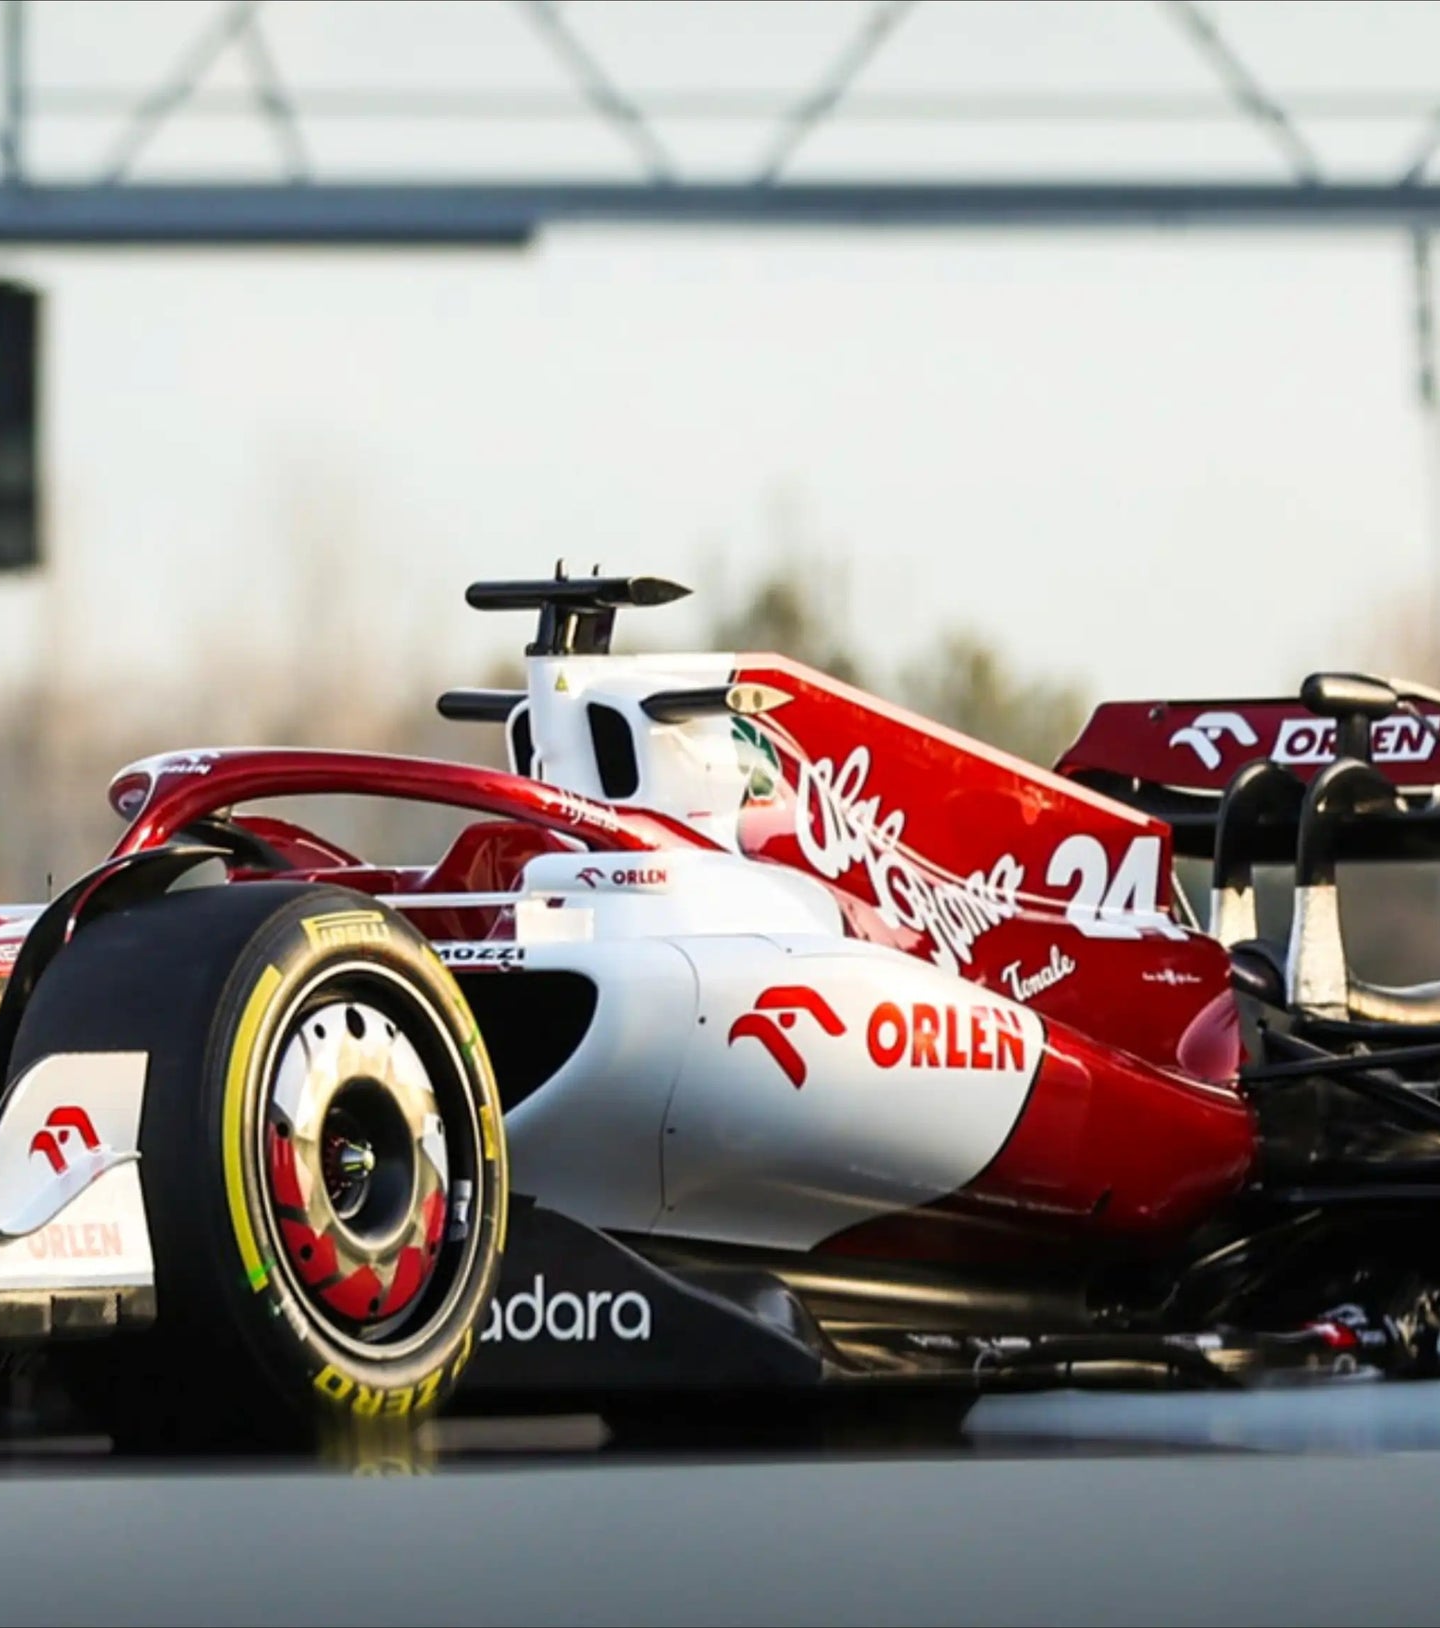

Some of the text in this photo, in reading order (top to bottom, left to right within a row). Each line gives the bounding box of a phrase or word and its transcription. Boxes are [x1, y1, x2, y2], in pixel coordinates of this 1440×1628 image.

[1283, 723, 1432, 757] OREN
[795, 746, 906, 879] Alfa
[611, 869, 667, 886] ORLEN
[1045, 833, 1190, 942] 24
[300, 910, 393, 953] PIRELLI
[1000, 943, 1077, 1002] Tonale
[866, 1000, 1025, 1073] ORLEN
[26, 1221, 124, 1262] ORLEN
